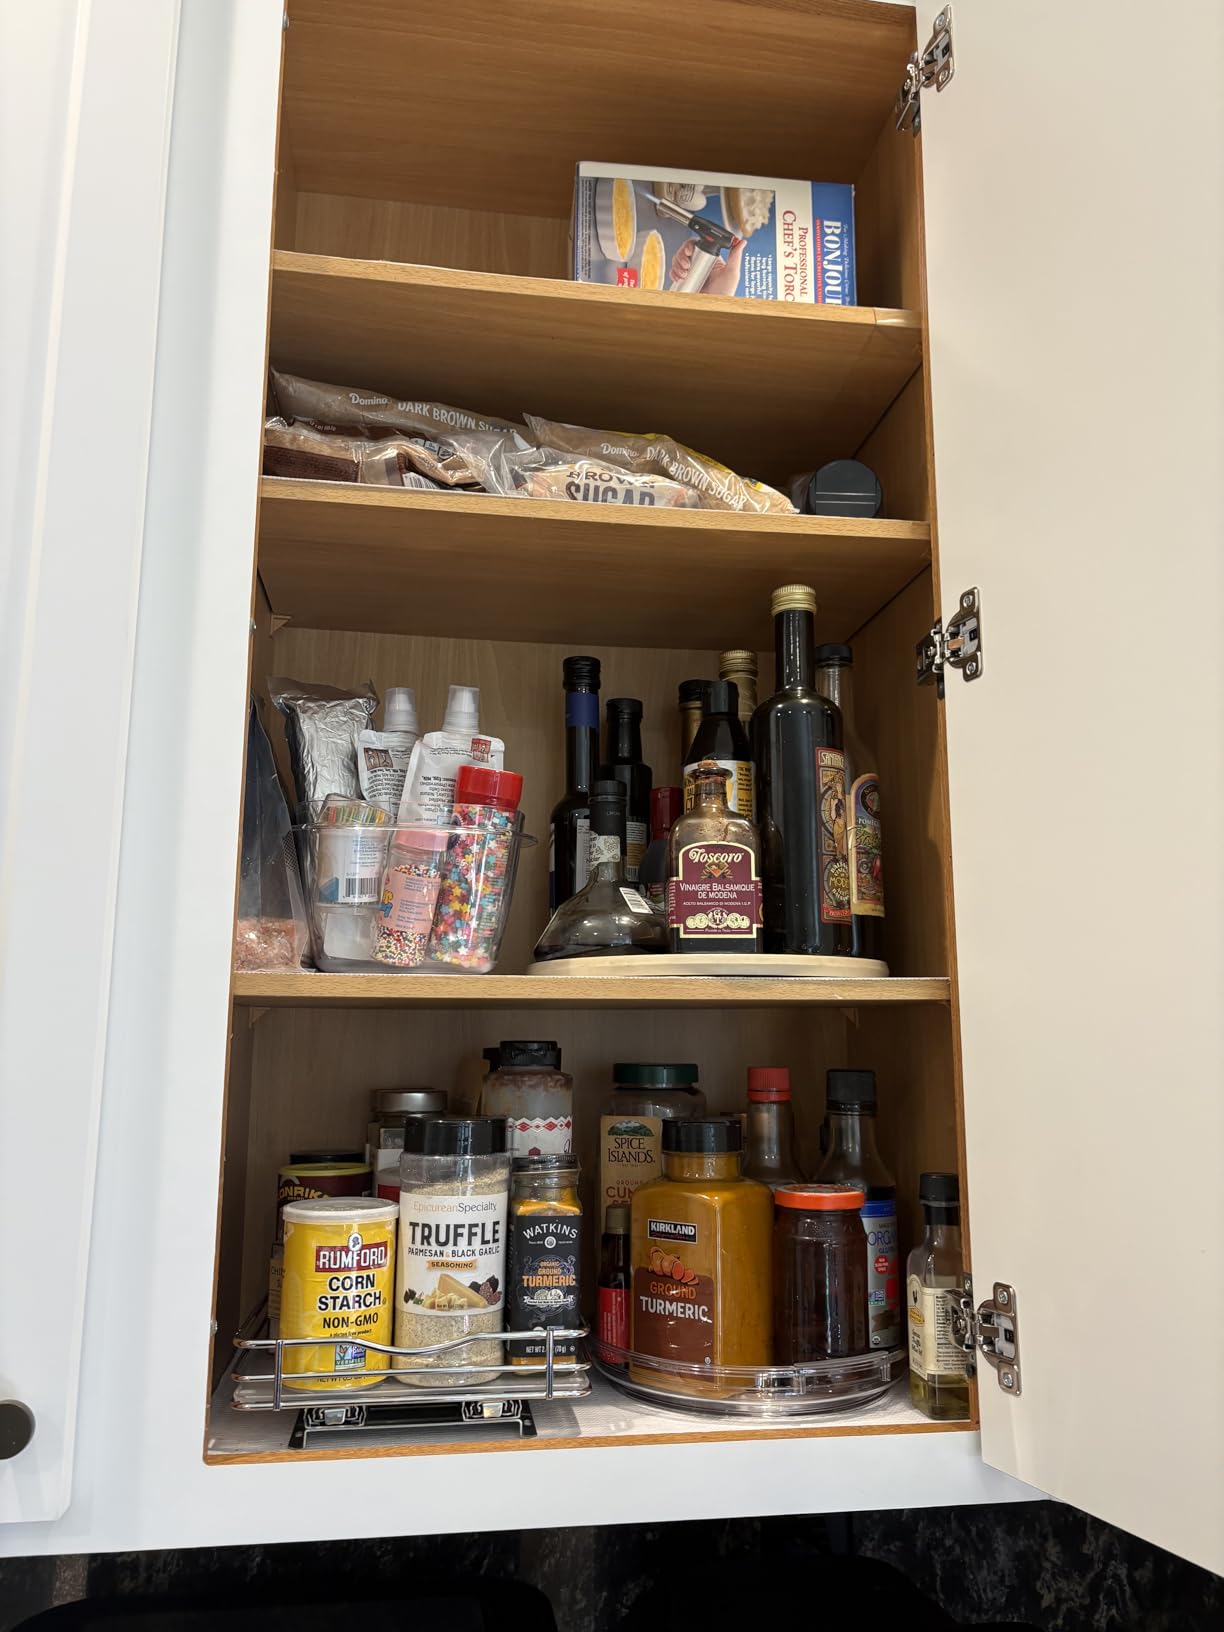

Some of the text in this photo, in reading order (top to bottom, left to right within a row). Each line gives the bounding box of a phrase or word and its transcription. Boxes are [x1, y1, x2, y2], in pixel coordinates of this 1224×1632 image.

[783, 210, 797, 302] CHEF'S TORC
[798, 226, 809, 297] PROFESSIONAL
[349, 393, 388, 406] Domino
[397, 402, 430, 416] DARK
[432, 407, 476, 430] BROWN
[600, 443, 637, 457] Domino
[647, 446, 747, 511] DARK BROWN SUGAR
[688, 848, 742, 863] Toscoro
[680, 882, 755, 892] VINAIGRE BALSAMIQUE
[614, 1137, 646, 1149] SPICE
[409, 1220, 500, 1247] TRUFFLE
[523, 1223, 578, 1239] WATKINS
[650, 1221, 695, 1236] KIRKLAND
[319, 1247, 386, 1269] RUMFORD
[408, 1247, 444, 1258] PARMESAN
[451, 1249, 476, 1258] BLACK
[478, 1246, 500, 1256] GARLIC
[431, 1261, 473, 1269] SEASONING
[328, 1273, 376, 1292] CORN
[522, 1274, 576, 1287] TURMERIC
[650, 1281, 697, 1299] GROUND
[317, 1291, 382, 1311] STARCH
[640, 1295, 709, 1321] TURMERIC
[322, 1312, 379, 1329] NON-GMO
